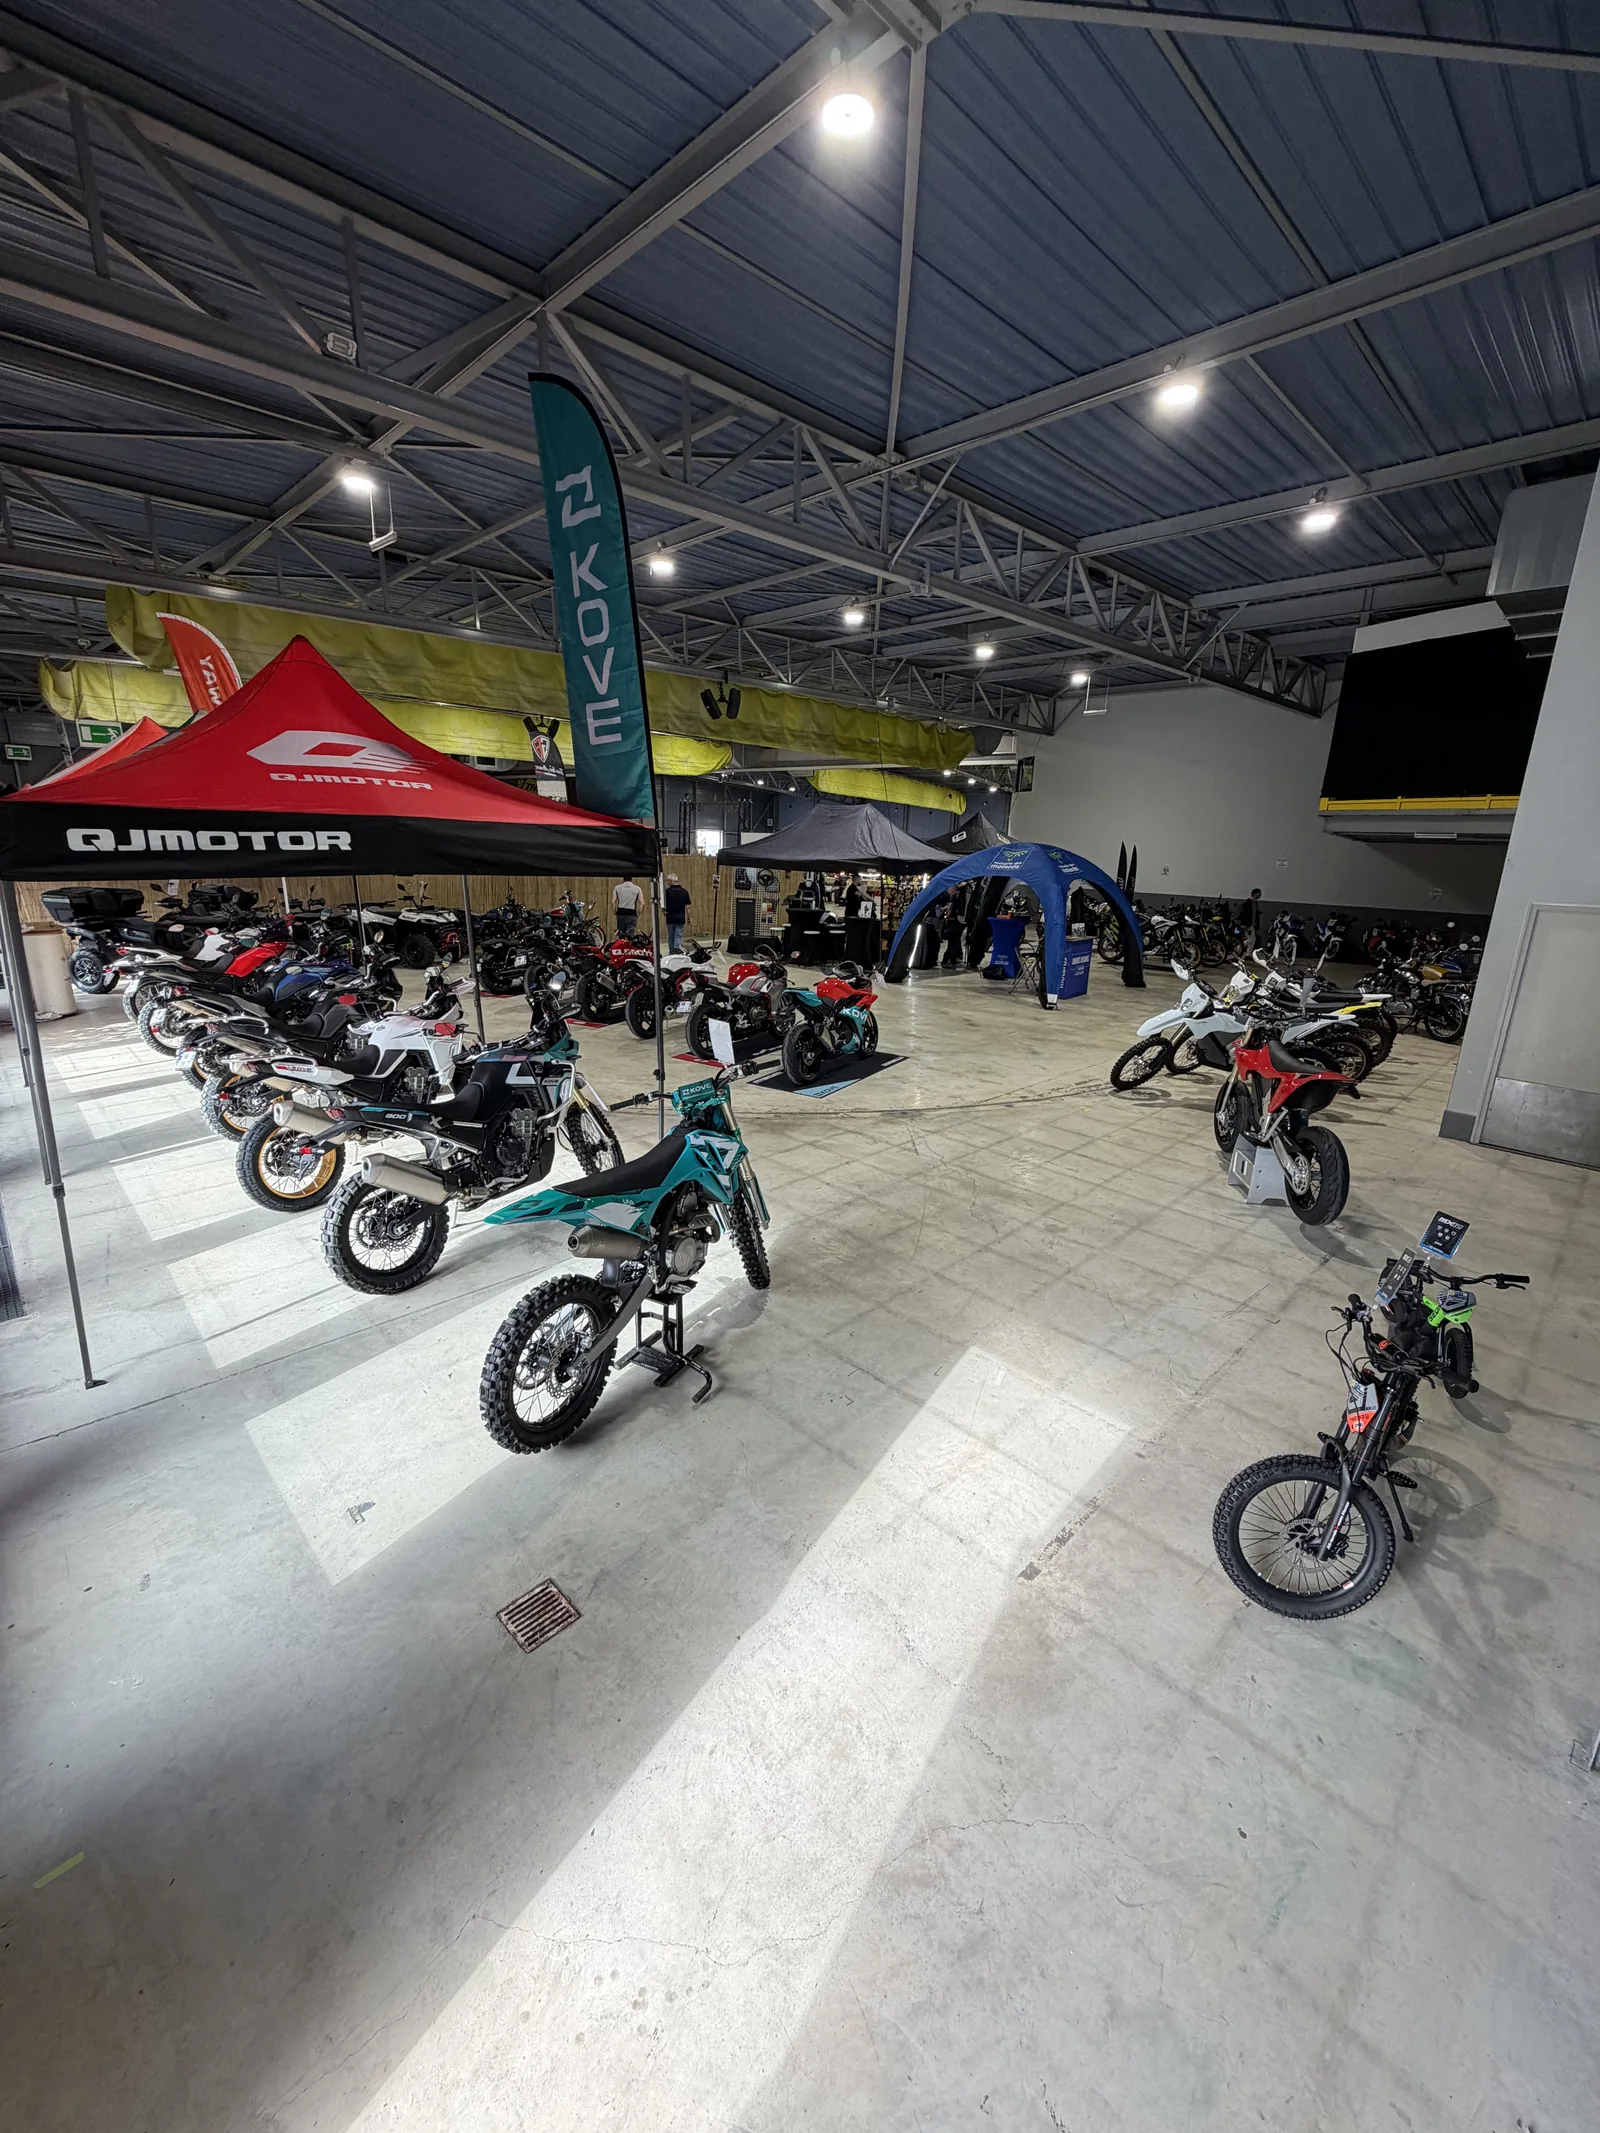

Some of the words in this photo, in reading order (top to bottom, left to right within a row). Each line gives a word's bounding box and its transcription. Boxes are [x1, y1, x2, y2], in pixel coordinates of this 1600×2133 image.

[570, 542, 622, 746] KOVE
[269, 772, 434, 791] QJMOTOR
[66, 828, 351, 851] QJMOTOR
[689, 1082, 712, 1094] KOVE
[385, 1112, 406, 1120] 800
[429, 1115, 443, 1129] X
